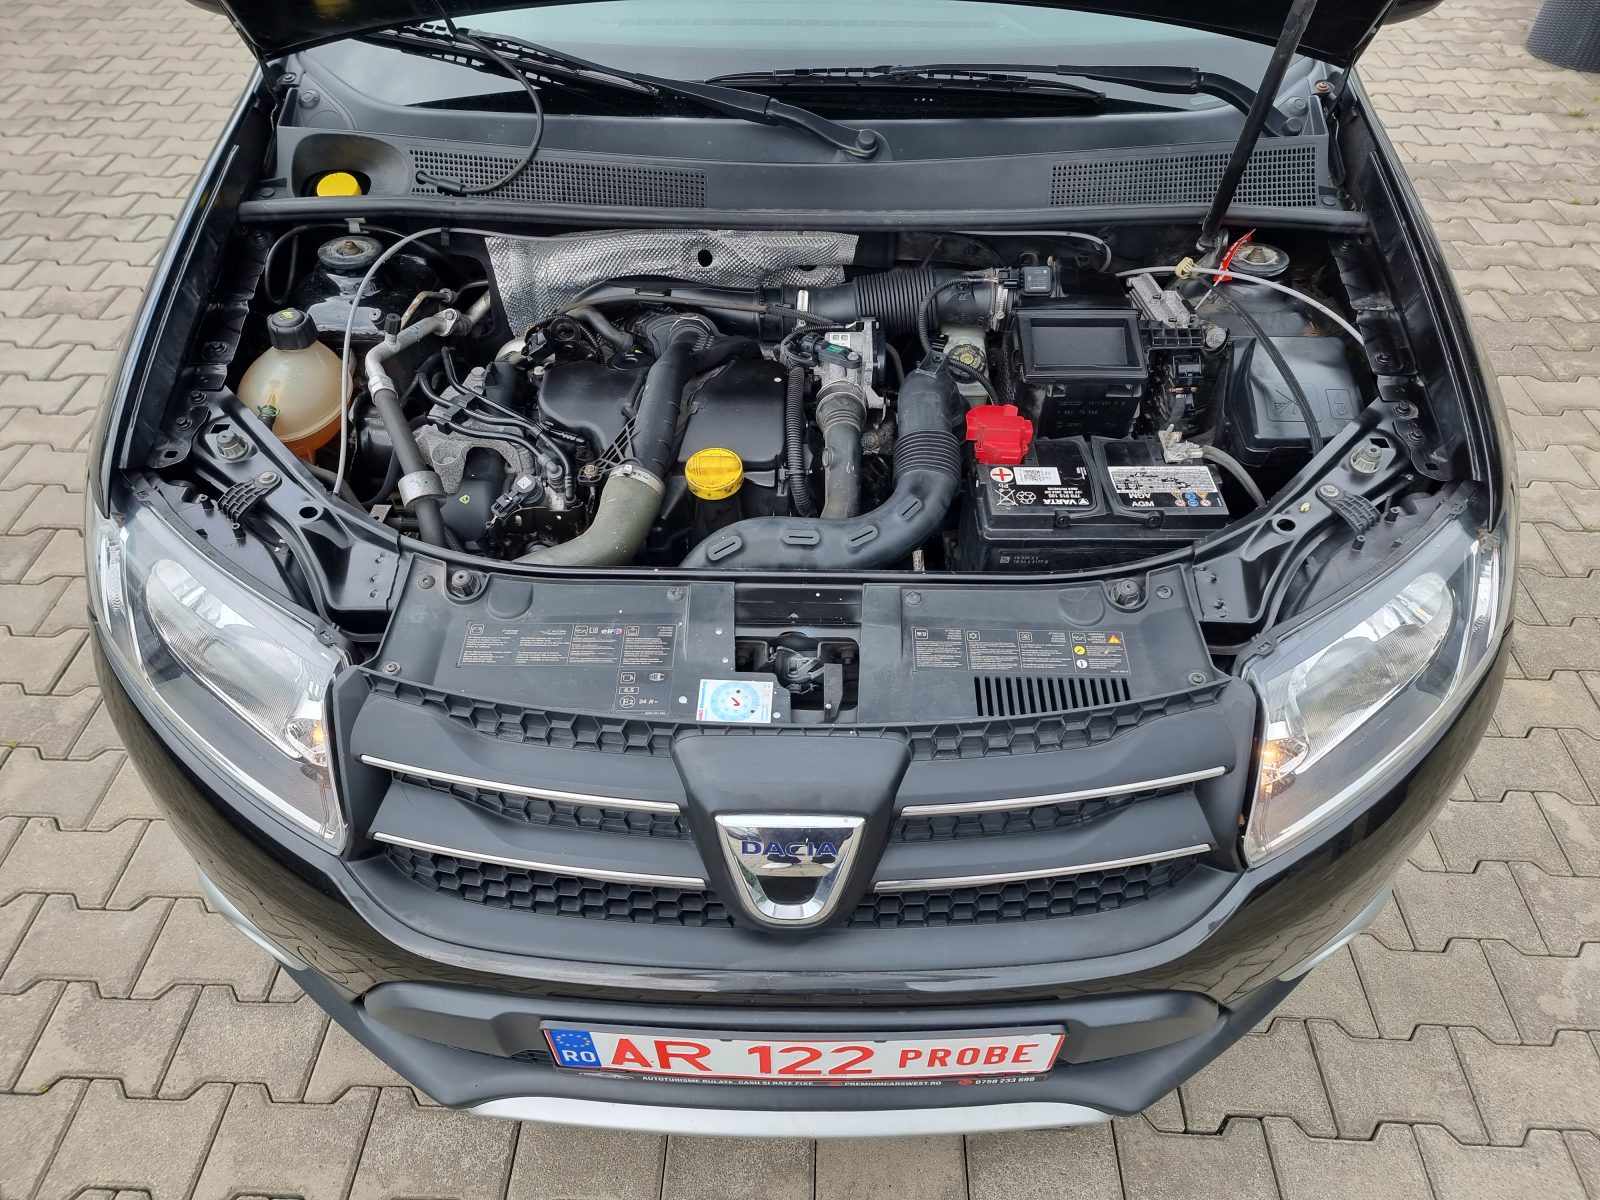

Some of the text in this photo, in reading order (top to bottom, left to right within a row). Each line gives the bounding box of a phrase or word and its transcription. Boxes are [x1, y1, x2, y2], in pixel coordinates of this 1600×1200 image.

[741, 840, 839, 857] DACIA
[561, 1050, 597, 1063] RO
[611, 1038, 1040, 1075] AR 122 PROBE
